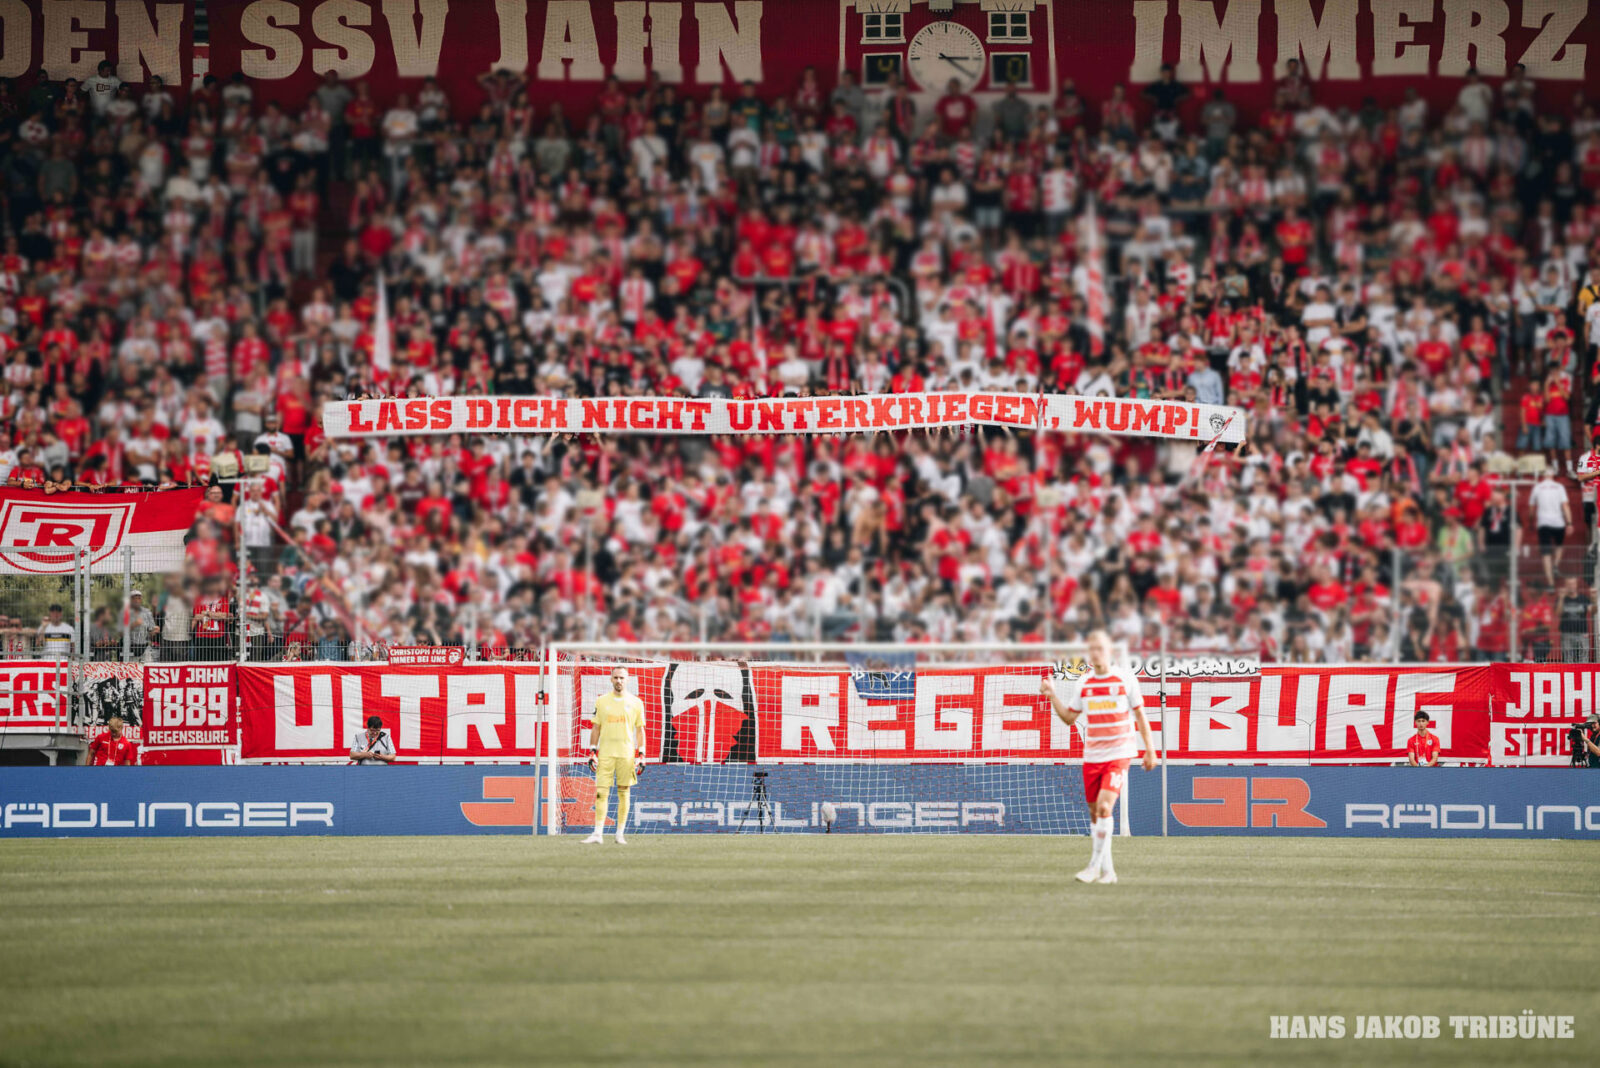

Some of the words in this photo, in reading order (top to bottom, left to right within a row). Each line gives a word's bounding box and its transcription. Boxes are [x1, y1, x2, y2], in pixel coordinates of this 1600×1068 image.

[240, 0, 449, 80] SSV
[491, 0, 763, 83] JAHN
[348, 401, 453, 432] LASS
[466, 399, 568, 428] DICH
[582, 400, 712, 430] NICHT
[727, 394, 1059, 430] UNTERKRIEGEN,
[1073, 400, 1200, 437] WUMP!
[390, 648, 430, 656] CHRISTOPH
[390, 656, 416, 664] IMMER
[149, 668, 180, 684] SSV
[186, 667, 229, 683] JAHN
[148, 687, 228, 726] 1889
[1506, 671, 1600, 718] JAH
[149, 730, 229, 744] REGENSBURG
[0, 802, 334, 828] ÄDLINGER
[634, 801, 1005, 828] RÄDLINGER
